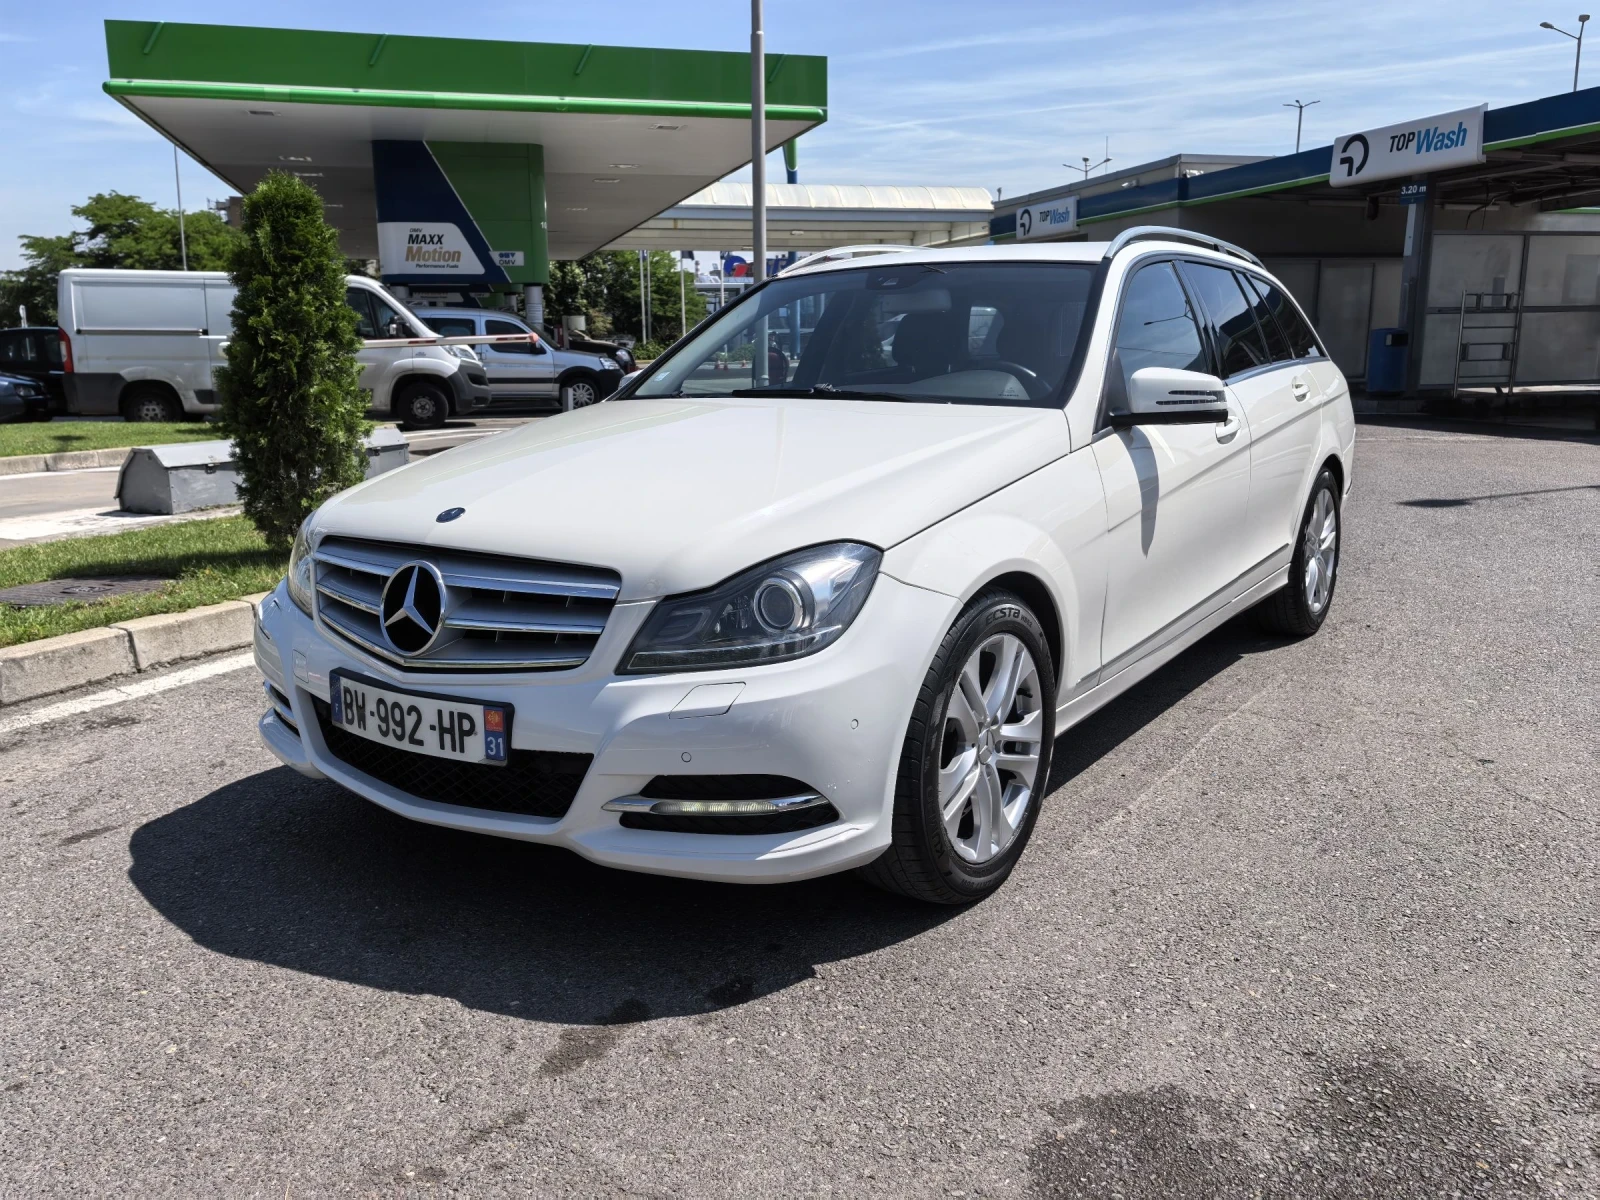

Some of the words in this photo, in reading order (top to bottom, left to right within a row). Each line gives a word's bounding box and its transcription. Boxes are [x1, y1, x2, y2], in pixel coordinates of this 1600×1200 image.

[1401, 185, 1417, 195] 3.20
[1419, 185, 1427, 193] m
[407, 233, 445, 245] MAXX
[405, 246, 462, 263] Motion
[343, 685, 476, 754] BW-992-HP
[486, 737, 504, 757] 31
